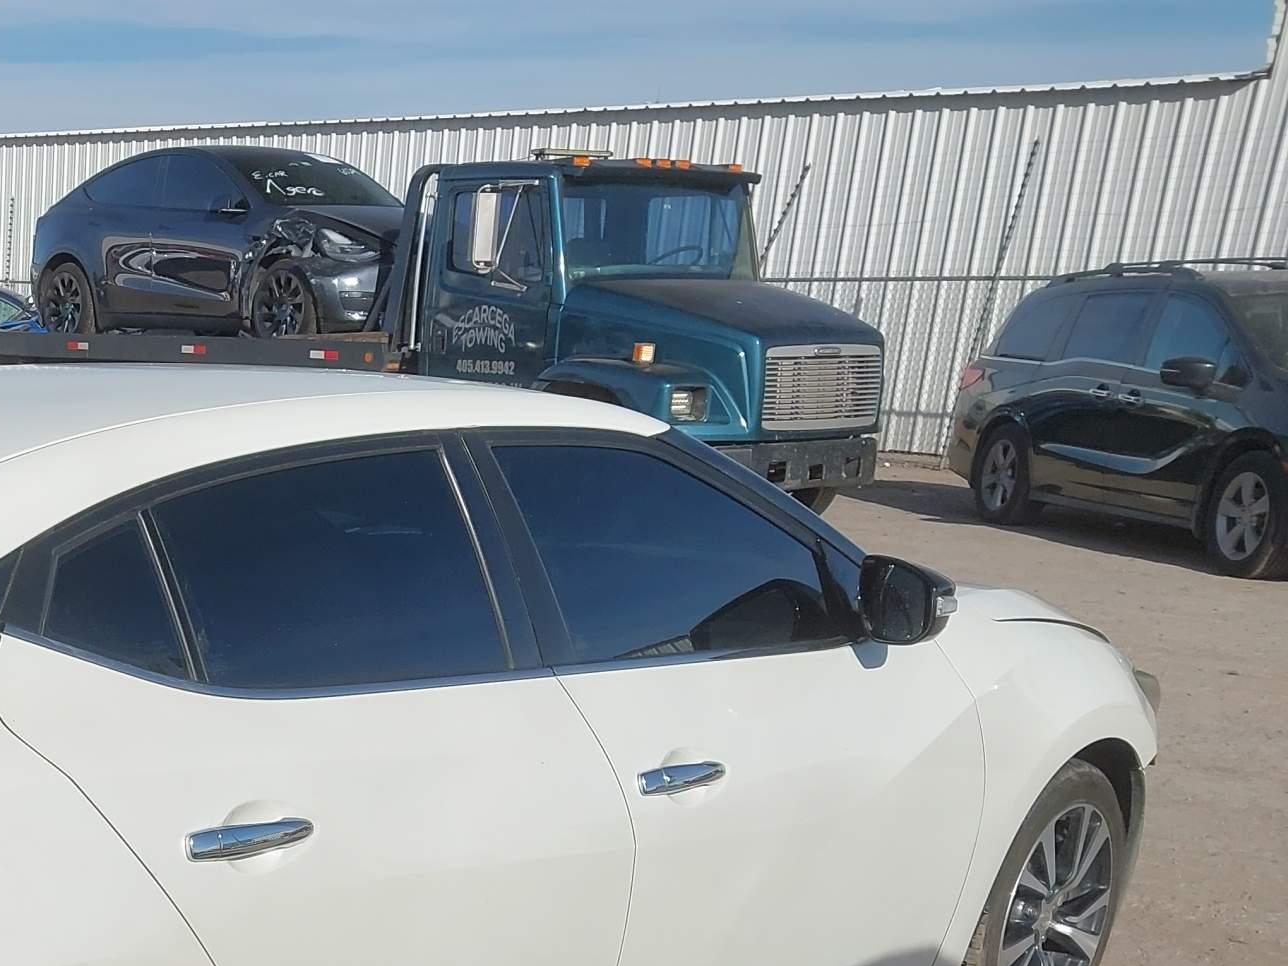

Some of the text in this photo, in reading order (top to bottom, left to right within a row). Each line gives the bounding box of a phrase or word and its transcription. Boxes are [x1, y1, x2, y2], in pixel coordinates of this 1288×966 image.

[453, 304, 516, 346] ESCARCEGA
[461, 326, 506, 353] TOWING
[456, 359, 515, 375] 405.413.9942
